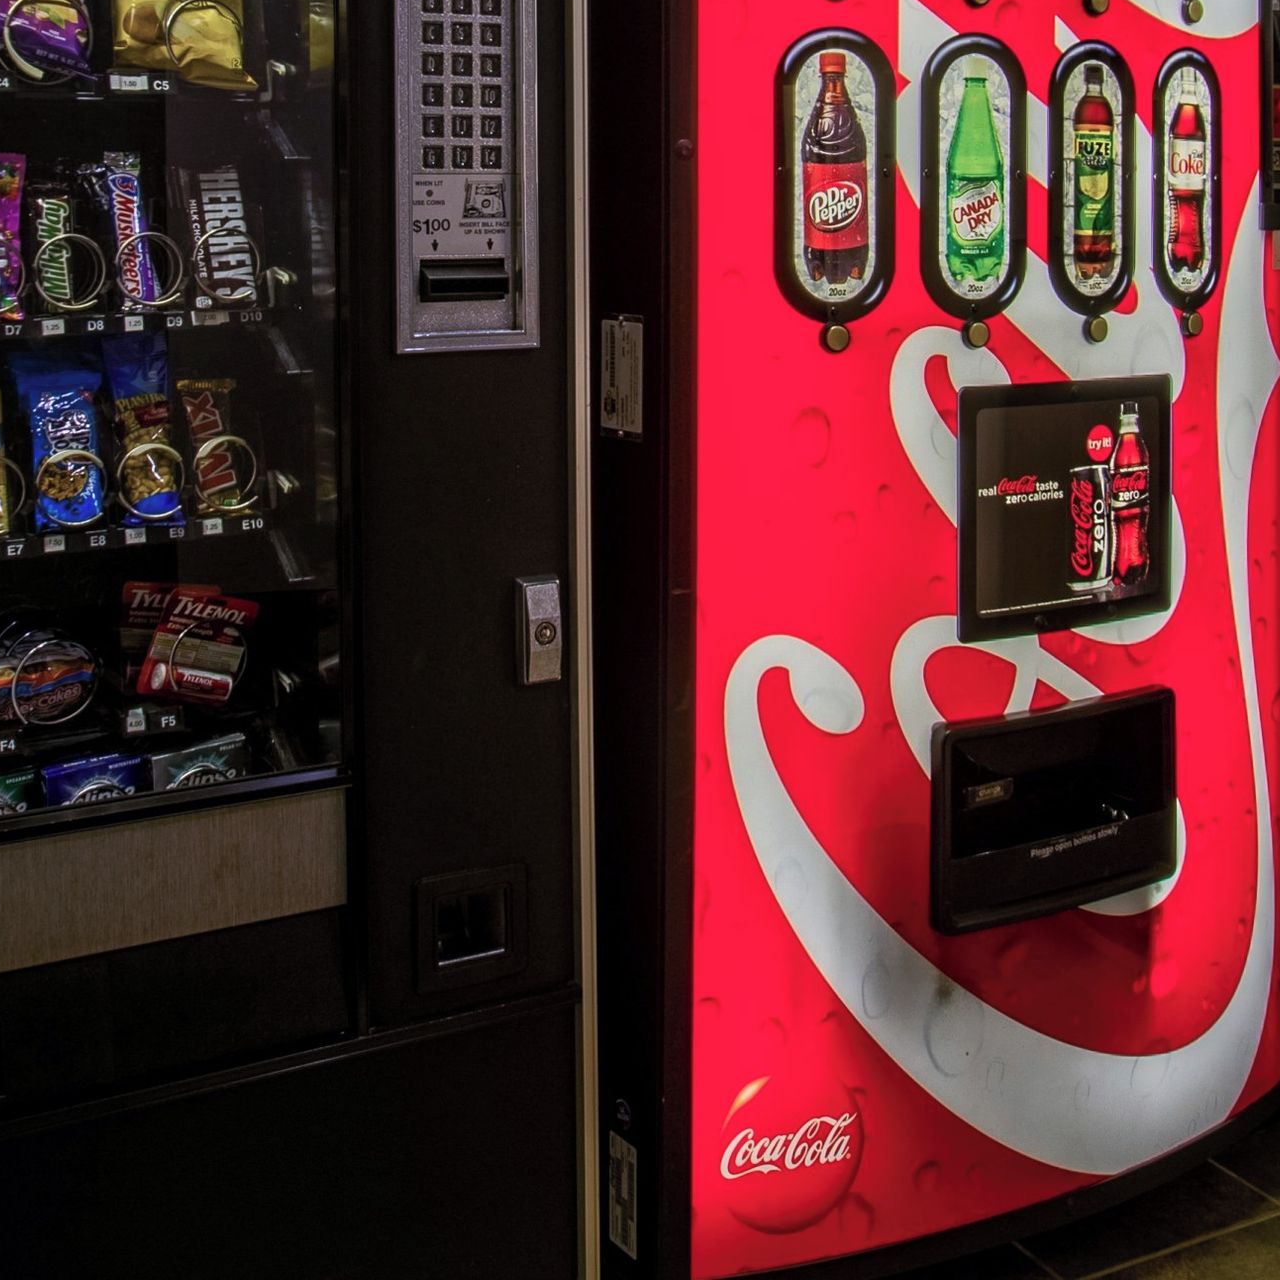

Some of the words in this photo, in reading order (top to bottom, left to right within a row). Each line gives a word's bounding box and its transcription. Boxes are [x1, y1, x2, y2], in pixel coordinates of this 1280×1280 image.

[153, 79, 170, 91] C5
[1077, 140, 1112, 157] FUZE
[1170, 151, 1205, 176] Coke
[118, 177, 136, 192] 3
[827, 185, 848, 207] Dr
[188, 198, 201, 223] MILK
[809, 192, 860, 224] Pepper
[953, 191, 1000, 226] CANADA
[36, 198, 70, 242] Way
[413, 218, 451, 235] $1.00
[966, 209, 994, 233] DRY
[113, 191, 143, 298] Musketeers
[198, 171, 258, 302] HERSHEY'S
[39, 241, 72, 300] Milky
[828, 286, 847, 298] 20oz
[966, 283, 984, 294] 20oz
[166, 315, 184, 327] D9
[240, 311, 264, 322] D10
[4, 324, 23, 336] D7
[87, 320, 106, 331] D8
[1088, 437, 1102, 452] try
[1102, 436, 1113, 449] it!
[978, 485, 998, 499] real
[998, 473, 1038, 496] Coca-Cola
[1035, 480, 1060, 492] taste
[1006, 492, 1028, 505] zero
[1028, 488, 1065, 503] calories
[1118, 489, 1141, 502] zero
[170, 527, 186, 538] E9
[242, 518, 265, 531] E10
[1070, 476, 1095, 577] Coca-Cola
[1093, 497, 1106, 553] zero
[90, 535, 107, 546] E8
[7, 544, 24, 556] E7
[172, 595, 250, 626] TYLENOL
[182, 673, 214, 687] TYLENOL
[161, 715, 177, 728] F5
[0, 738, 17, 752] F4
[1030, 845, 1055, 858] Please
[1054, 840, 1073, 854] open
[1073, 832, 1097, 848] bottles
[1097, 825, 1119, 840] slowly
[720, 1111, 857, 1180] Coca-Cola
